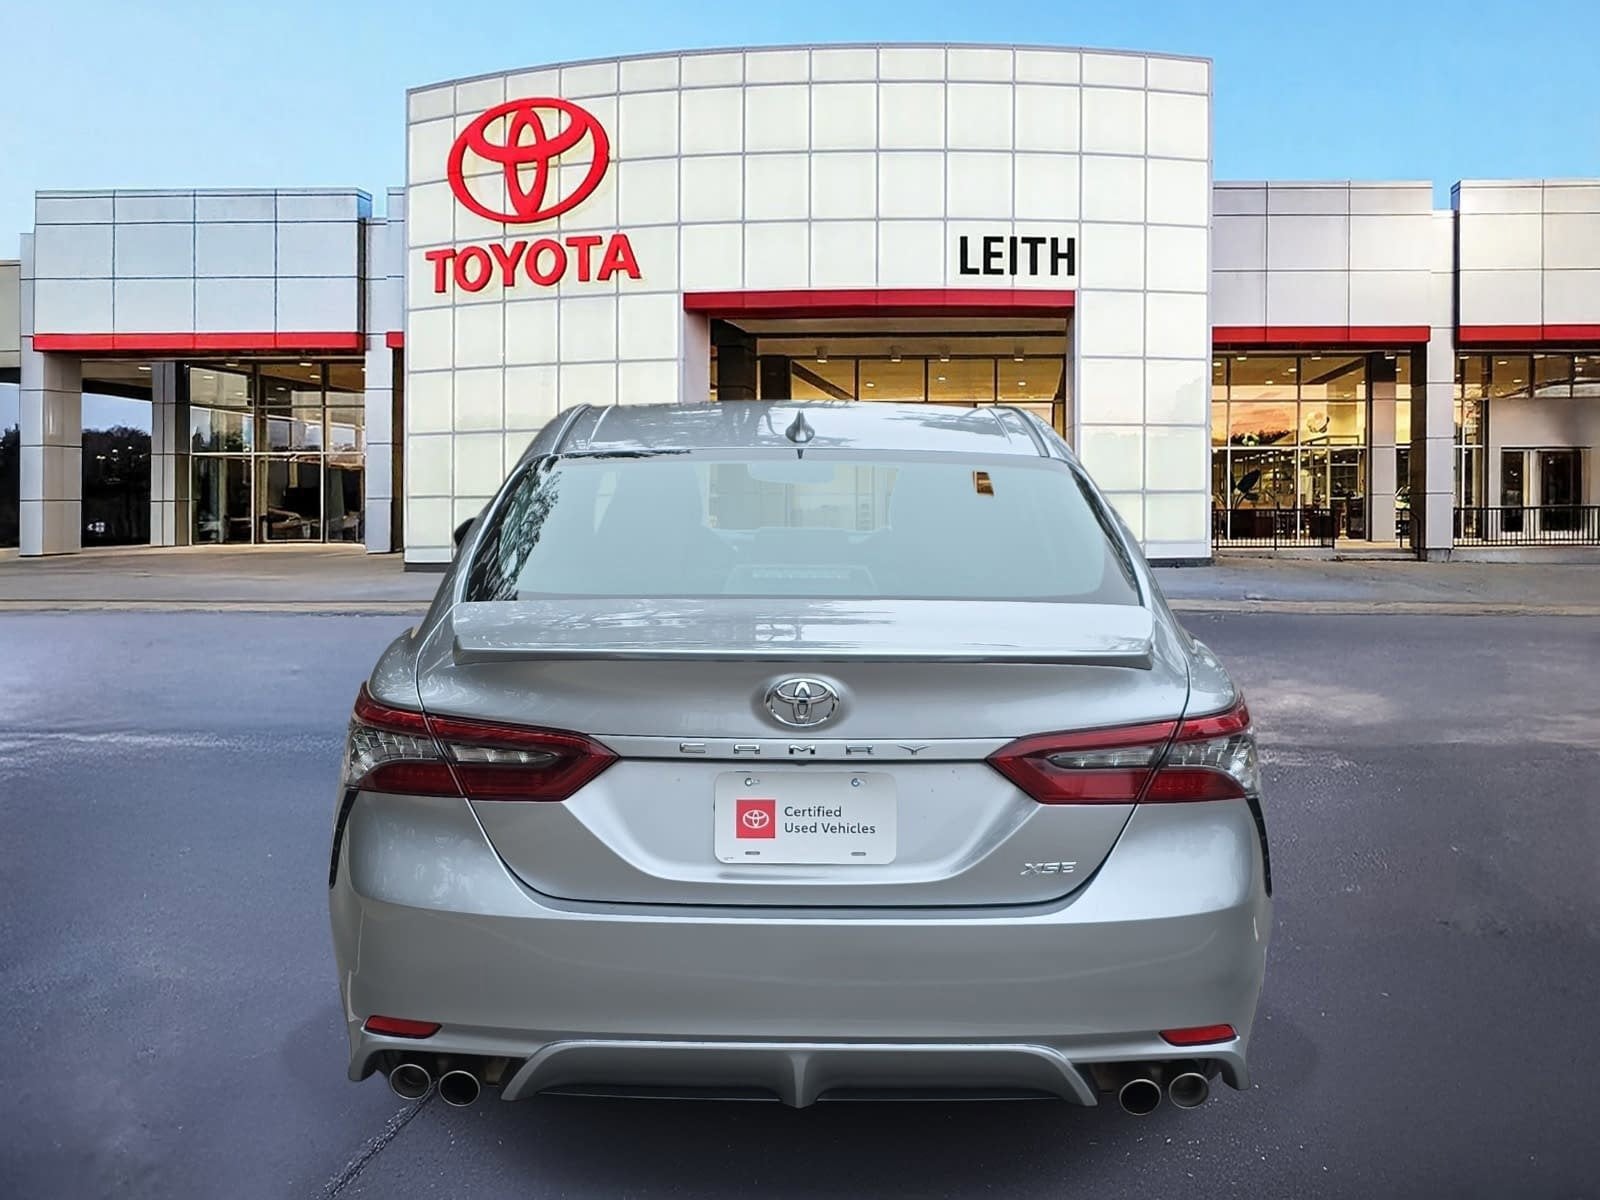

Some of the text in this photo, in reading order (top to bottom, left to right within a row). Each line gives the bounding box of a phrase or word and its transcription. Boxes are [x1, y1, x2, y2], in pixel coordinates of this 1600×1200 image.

[959, 236, 1075, 276] LEITH
[425, 233, 641, 293] TOYOTA
[679, 742, 931, 755] CAMRY
[784, 806, 842, 817] Certified
[784, 822, 876, 834] Used Vehicles
[1020, 861, 1077, 875] XSE
